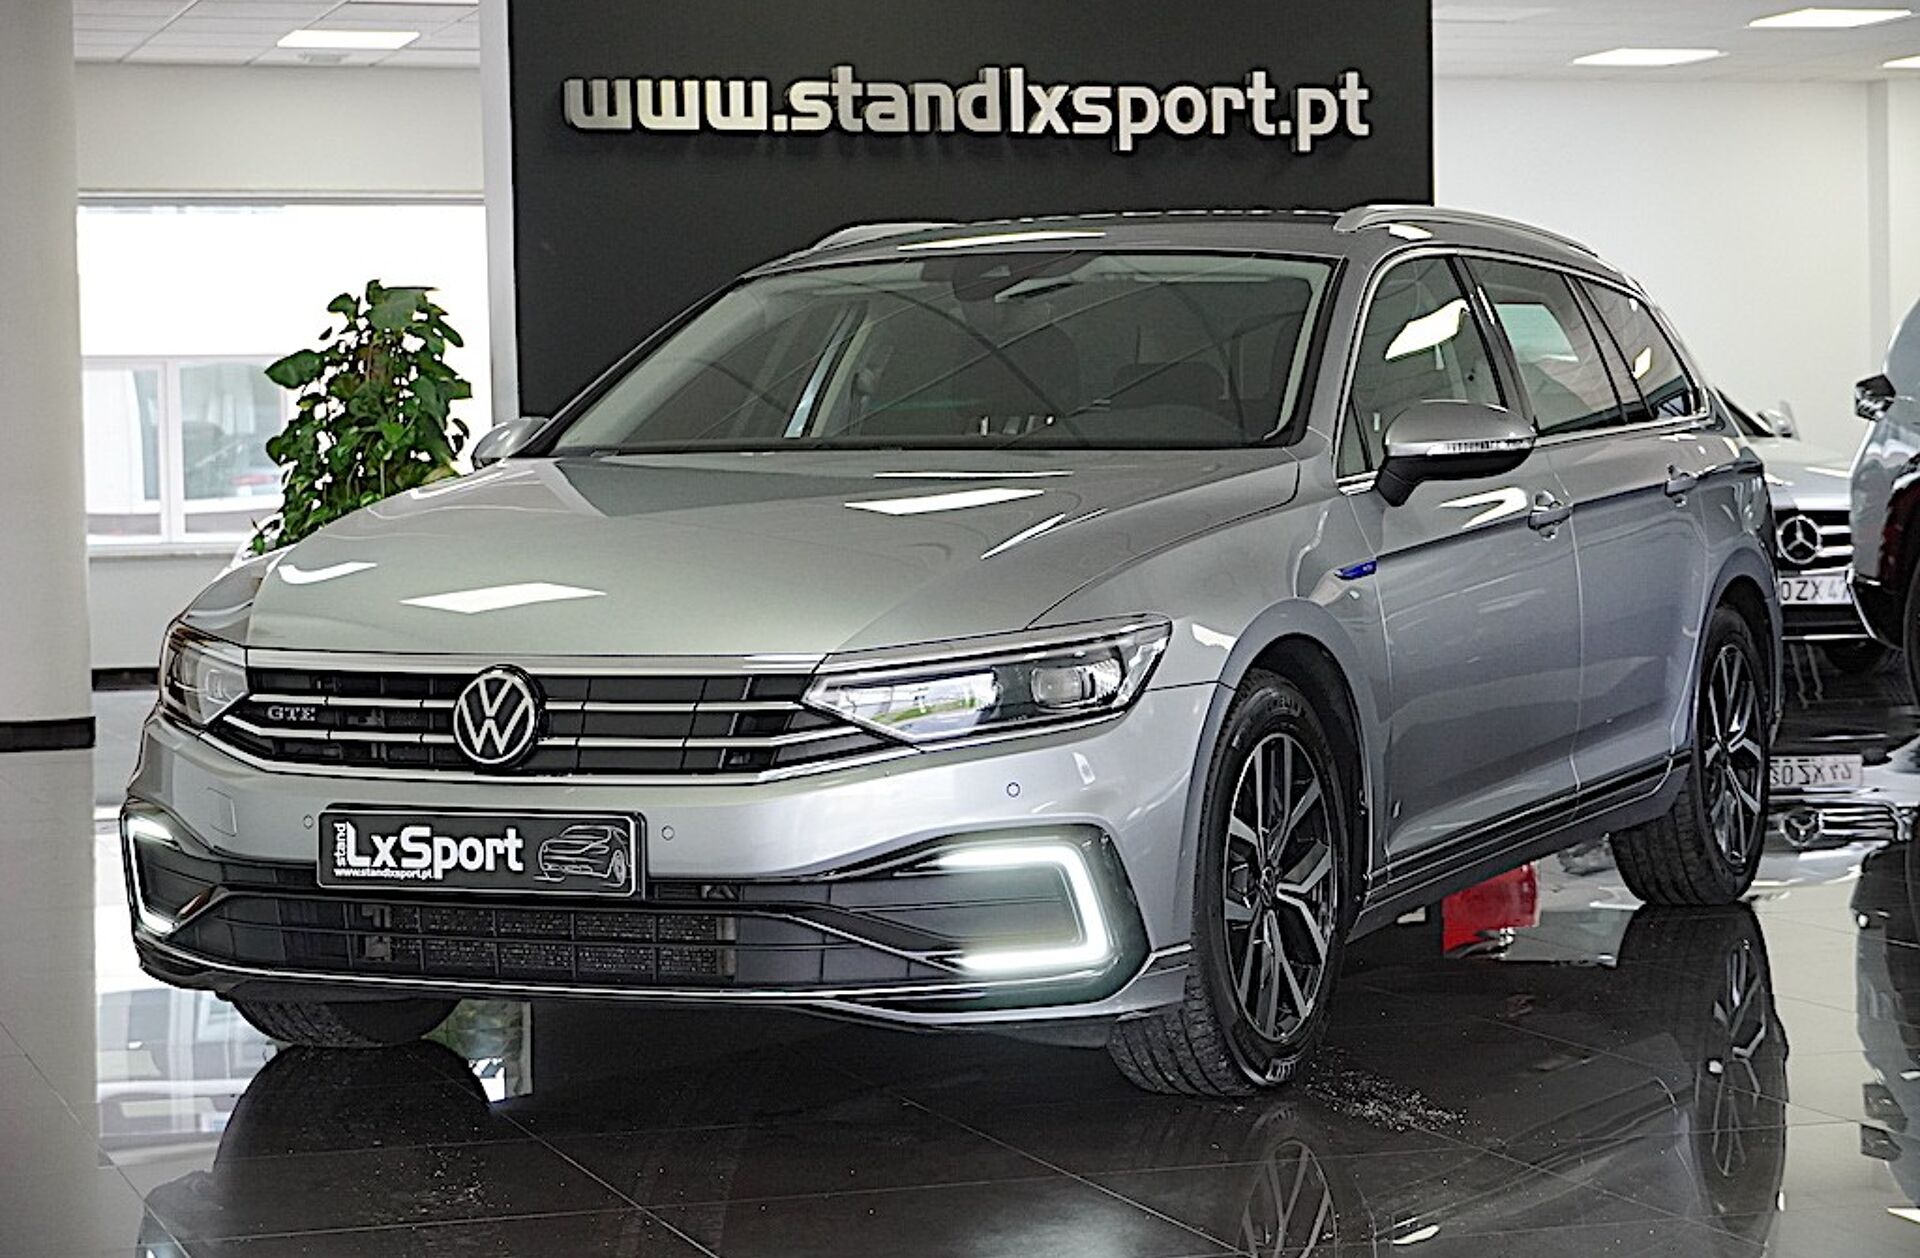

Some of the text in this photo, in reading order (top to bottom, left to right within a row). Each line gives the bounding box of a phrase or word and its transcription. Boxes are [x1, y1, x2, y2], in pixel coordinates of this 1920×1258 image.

[563, 65, 1370, 152] www.standlxsport.pt
[267, 704, 316, 721] GTE
[333, 822, 346, 868] stand
[346, 821, 524, 880] LxSport
